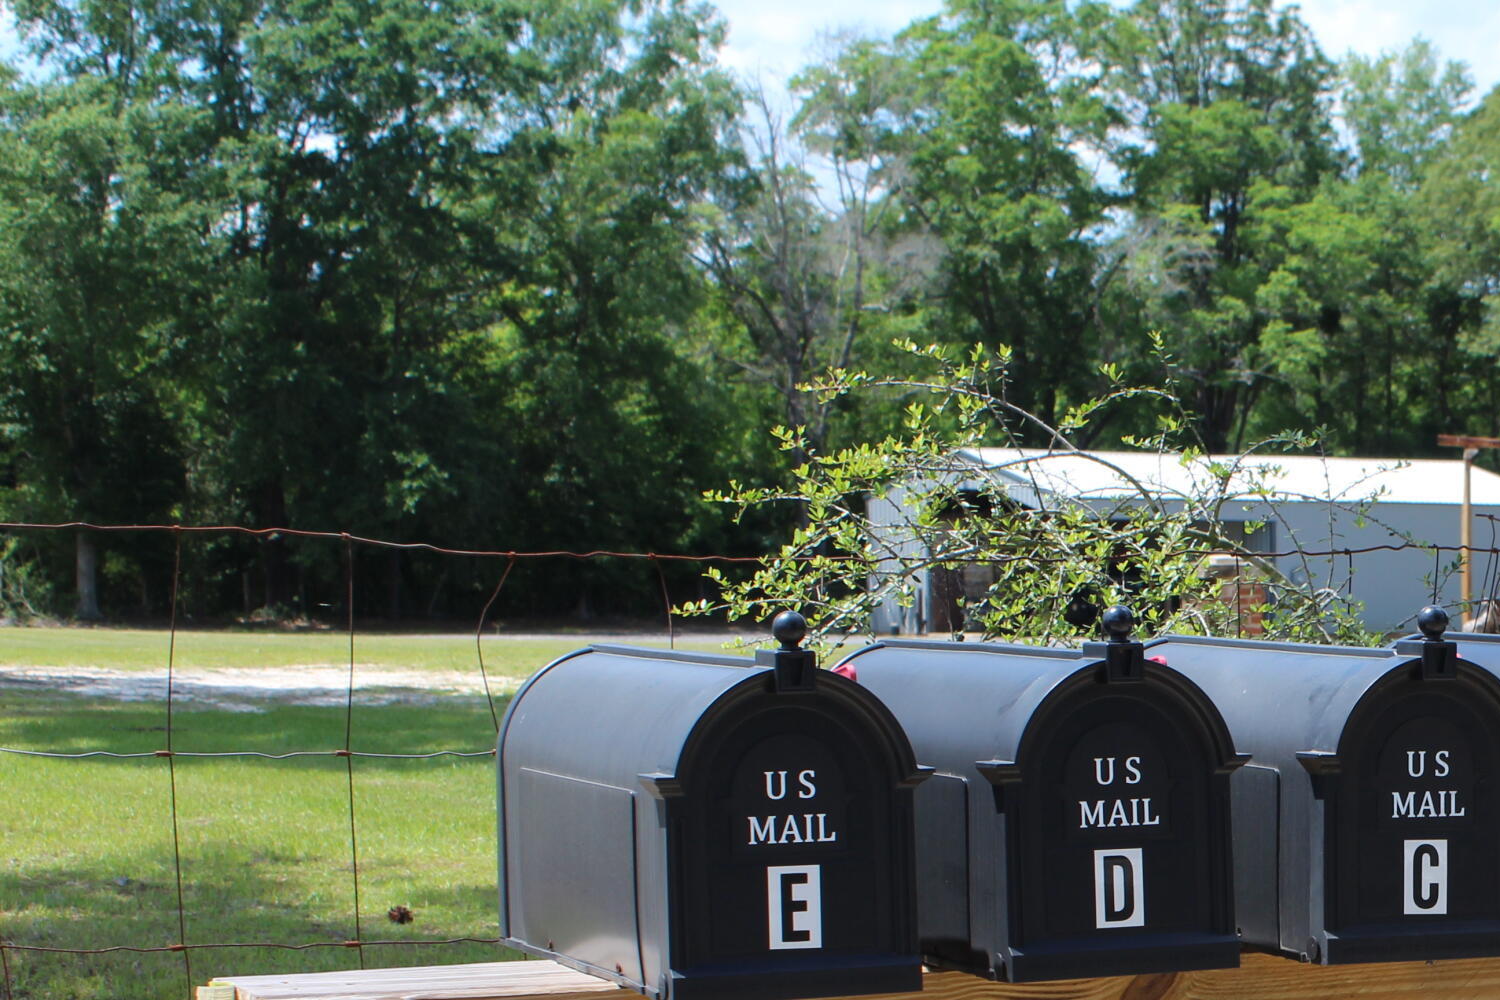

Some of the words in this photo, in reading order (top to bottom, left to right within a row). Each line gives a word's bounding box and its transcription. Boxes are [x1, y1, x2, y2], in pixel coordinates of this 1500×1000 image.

[747, 813, 837, 845] MAIL
[1078, 797, 1160, 829] MAIL
[1391, 790, 1465, 819] MAIL
[1102, 854, 1135, 923] D
[1412, 843, 1440, 910] C
[780, 872, 811, 943] E
